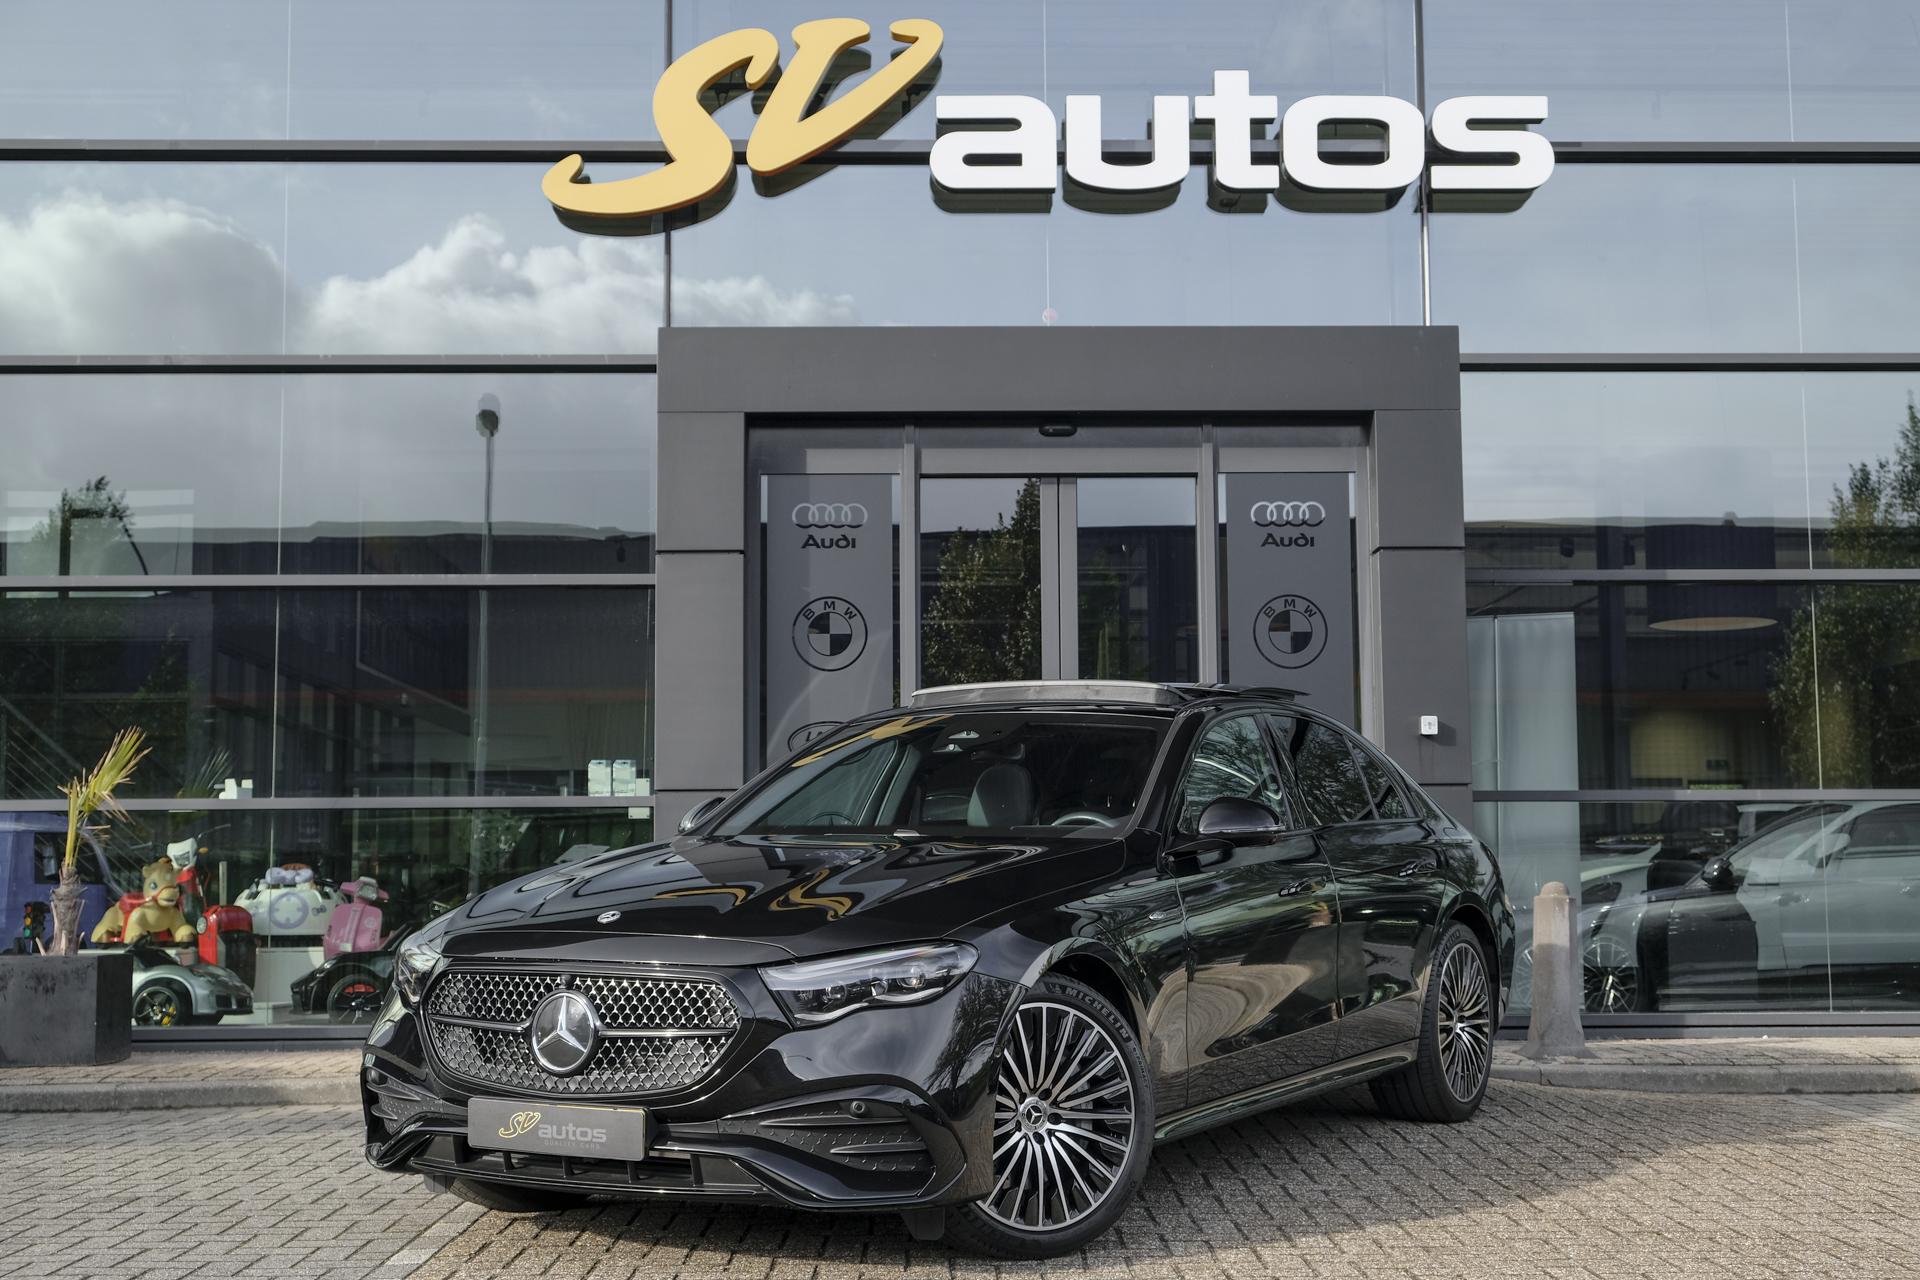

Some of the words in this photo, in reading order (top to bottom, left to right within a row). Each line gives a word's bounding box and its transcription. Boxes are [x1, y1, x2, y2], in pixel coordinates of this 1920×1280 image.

[542, 17, 943, 216] SV
[930, 70, 1556, 191] autos
[801, 534, 856, 549] Audi
[1260, 533, 1315, 548] Audi
[802, 601, 857, 621] BMW
[1263, 599, 1317, 619] BMW
[1065, 986, 1130, 1039] MICHELIN
[498, 1111, 542, 1138] SV
[538, 1123, 607, 1143] autos
